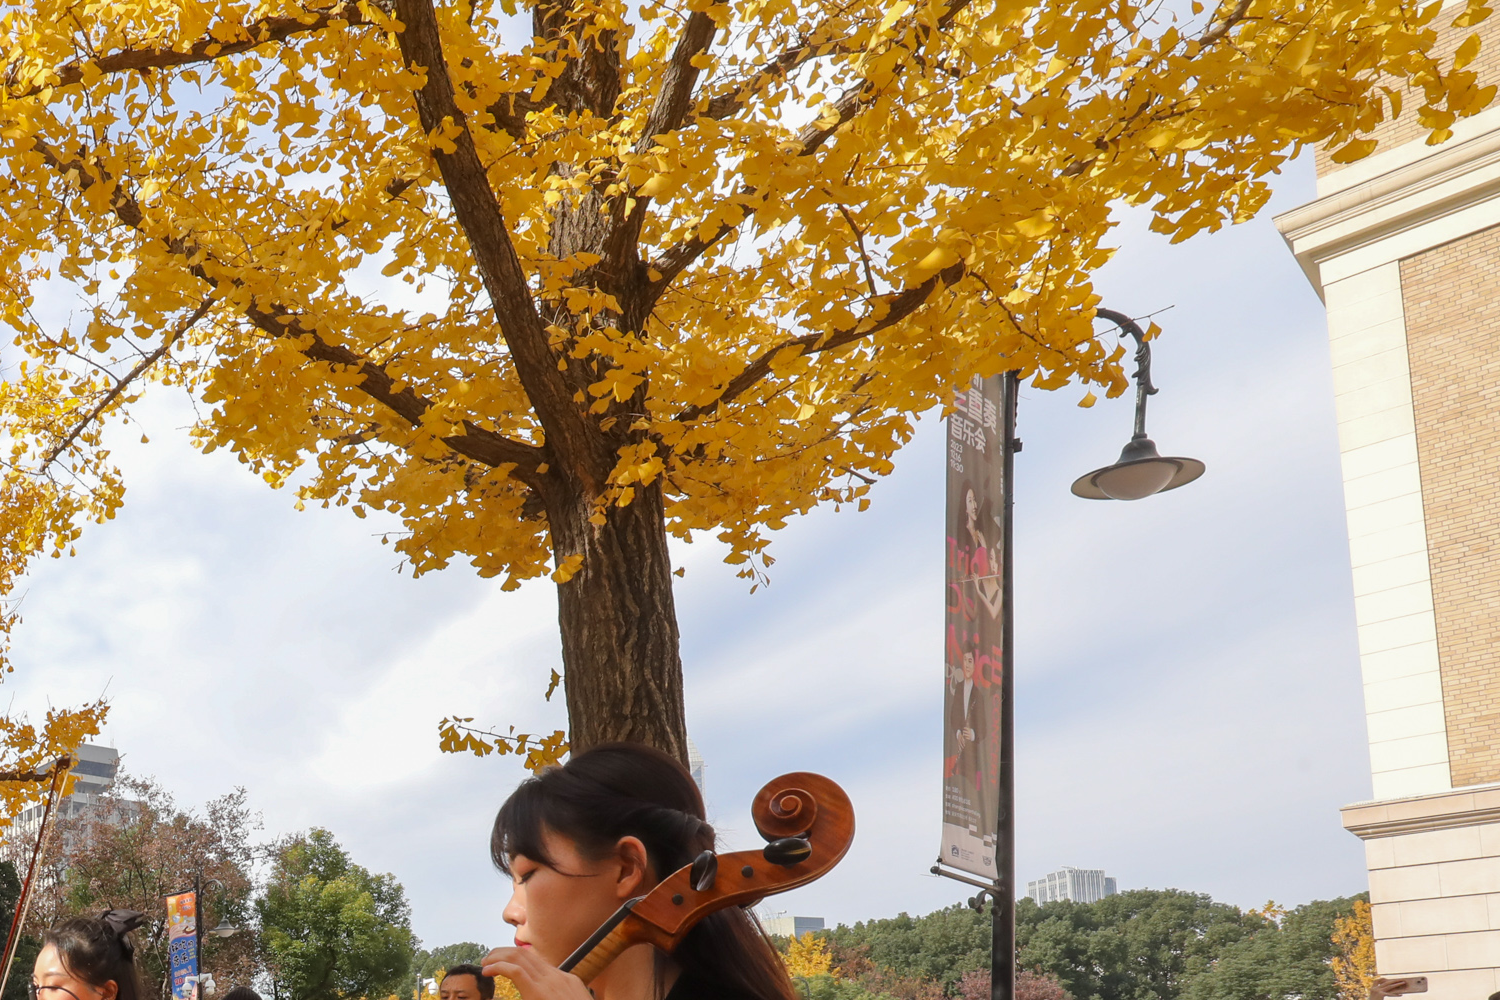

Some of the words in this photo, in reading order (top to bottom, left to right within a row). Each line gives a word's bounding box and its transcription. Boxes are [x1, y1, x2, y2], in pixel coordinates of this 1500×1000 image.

[950, 413, 986, 454] 音乐会
[950, 439, 963, 454] 2023
